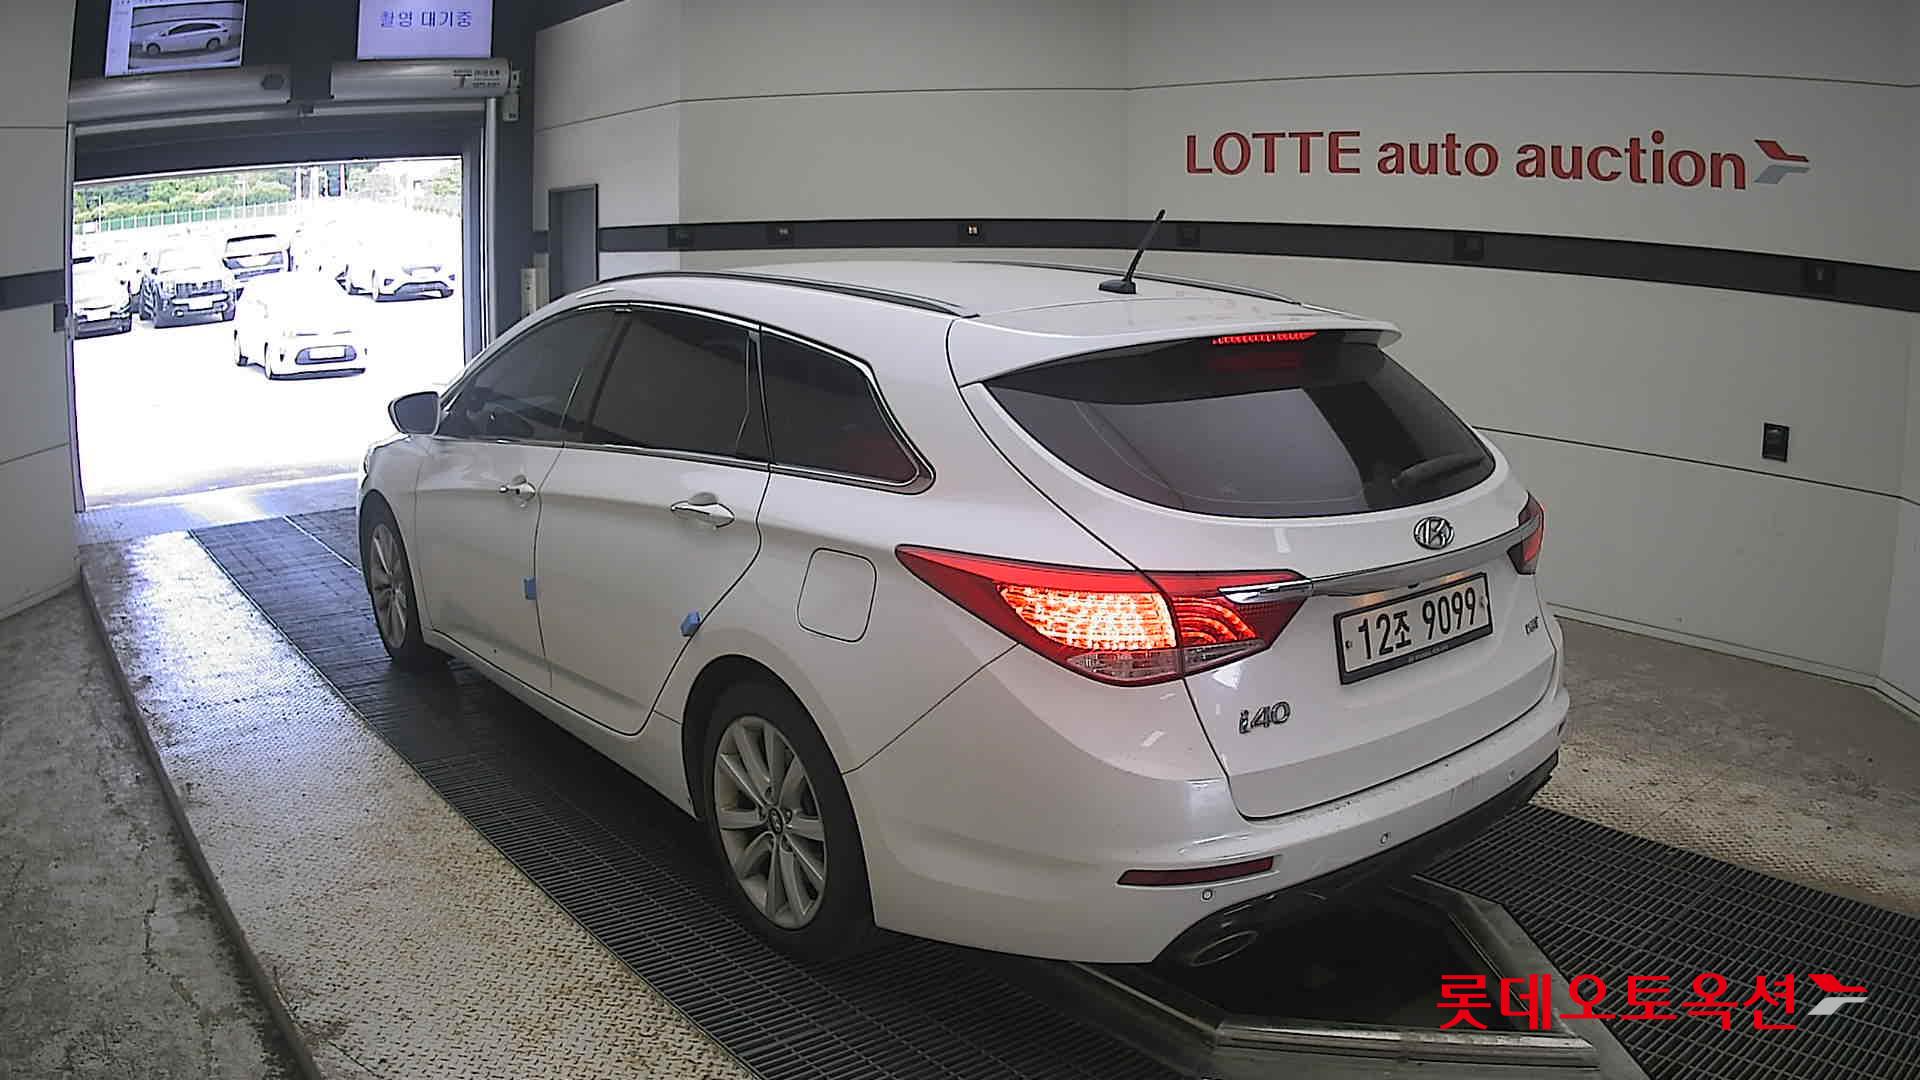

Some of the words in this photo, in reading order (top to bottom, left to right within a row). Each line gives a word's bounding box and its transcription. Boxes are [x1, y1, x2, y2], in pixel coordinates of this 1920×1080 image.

[421, 11, 472, 28] 대기중
[1186, 131, 1361, 175] LOTTE
[1377, 133, 1499, 176] auto
[1515, 131, 1746, 189] auction
[1358, 610, 1412, 660] 12조
[1422, 587, 1476, 640] 9099
[1239, 701, 1291, 734] i40
